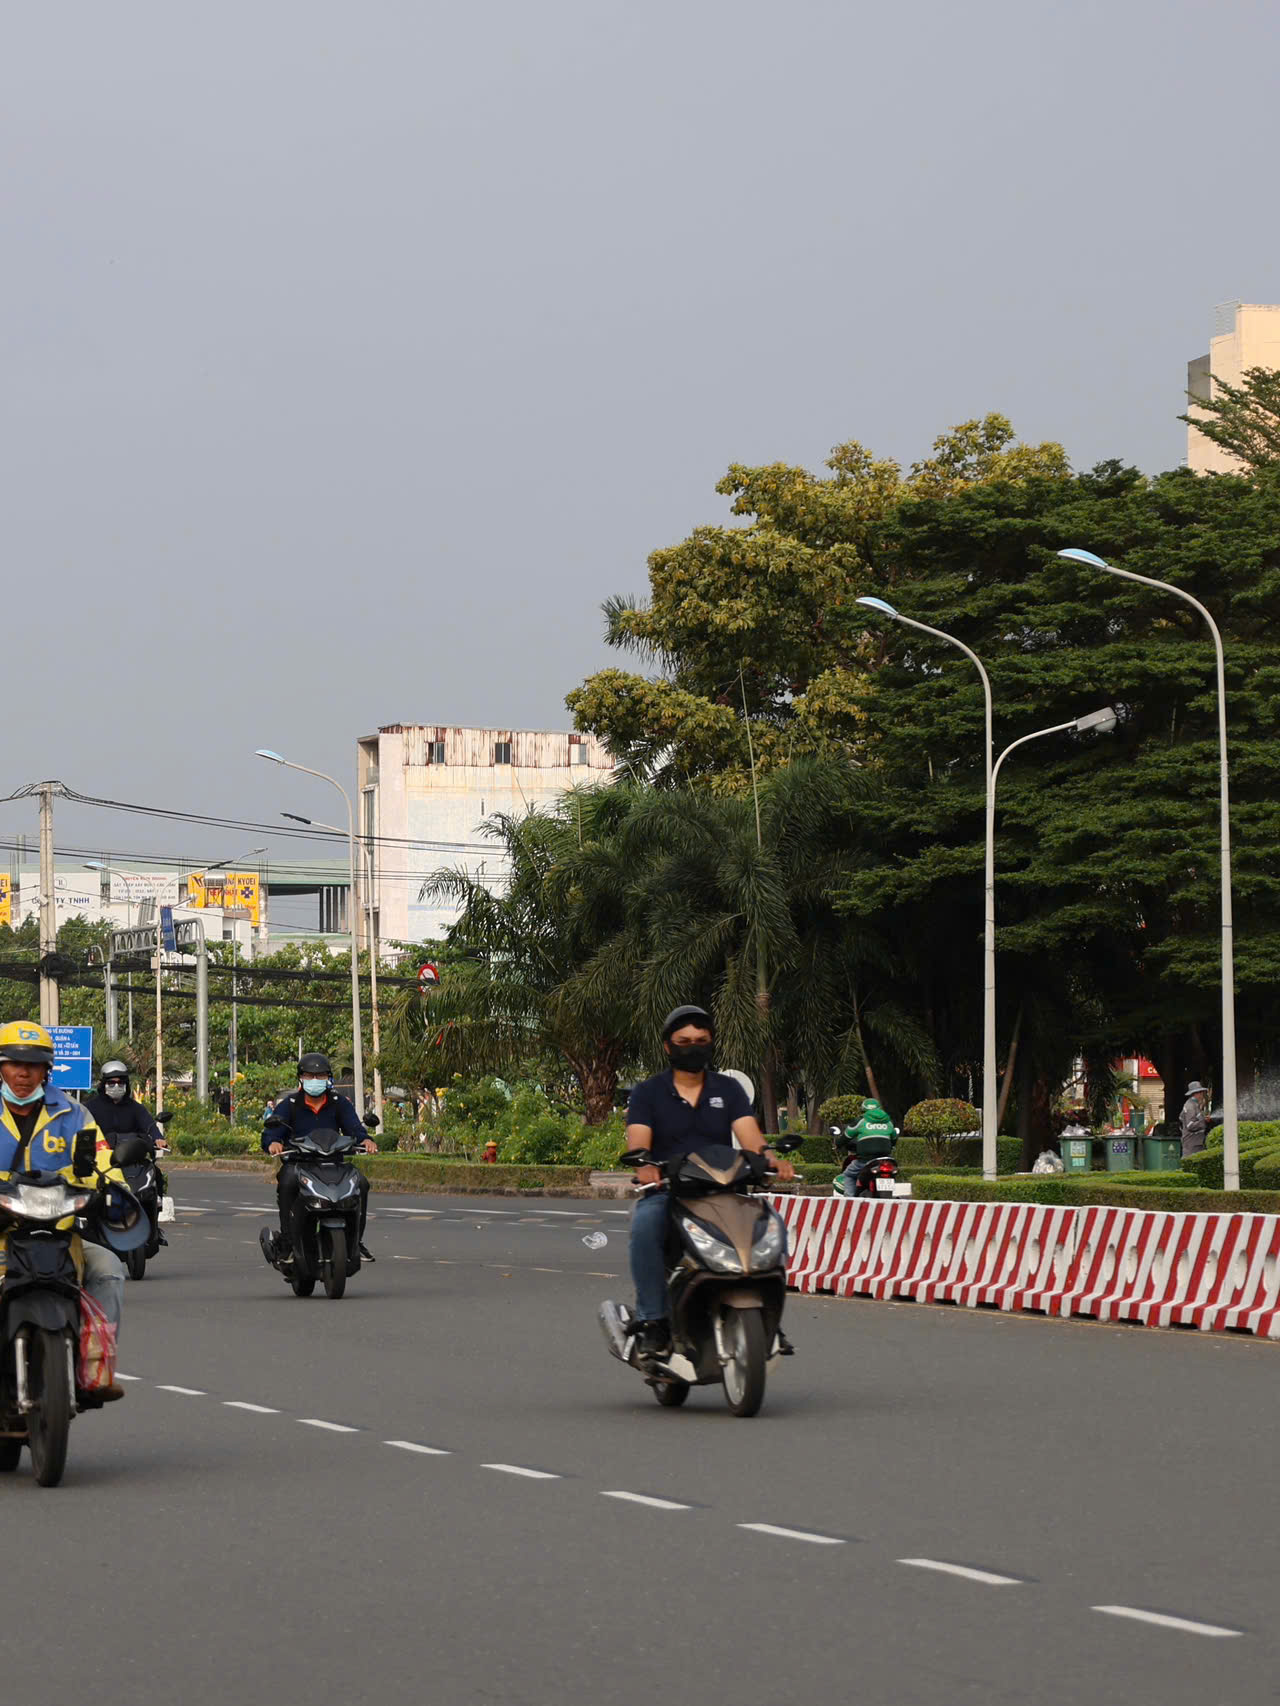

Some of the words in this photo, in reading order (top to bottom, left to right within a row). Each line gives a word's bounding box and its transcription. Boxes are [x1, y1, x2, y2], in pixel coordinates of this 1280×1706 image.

[237, 878, 256, 886] KYOEI
[18, 1028, 40, 1041] be
[43, 1129, 67, 1153] be
